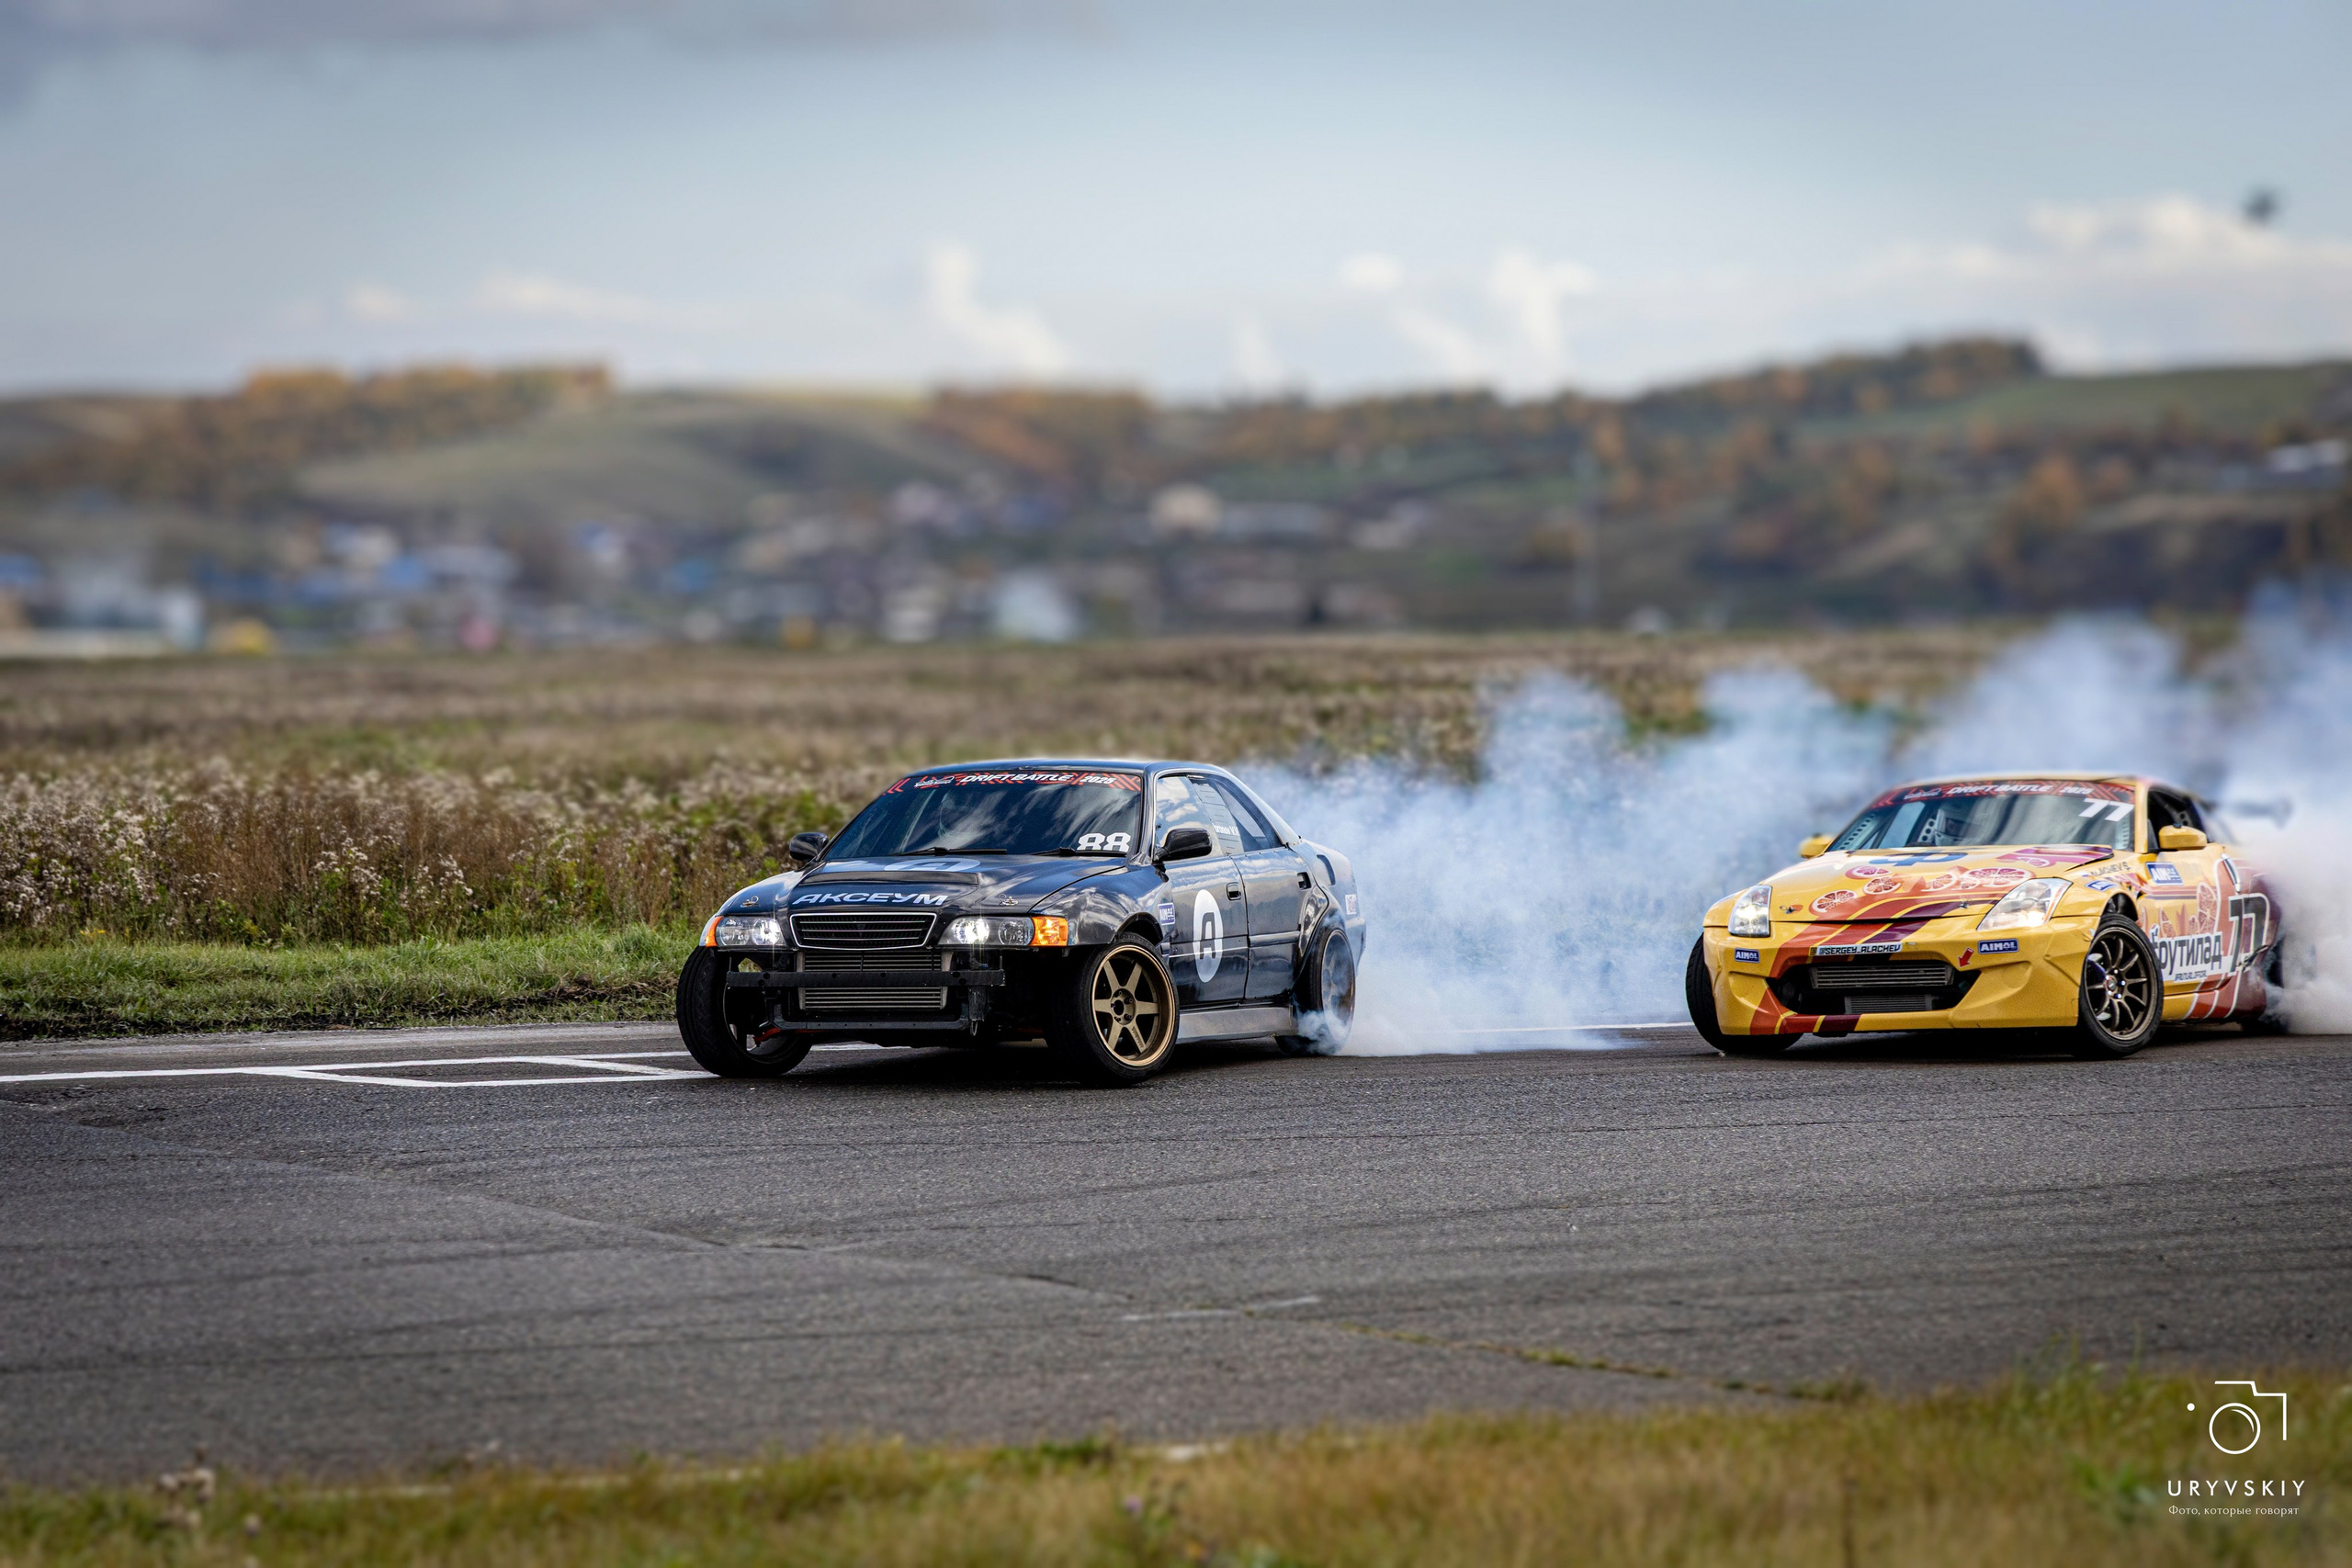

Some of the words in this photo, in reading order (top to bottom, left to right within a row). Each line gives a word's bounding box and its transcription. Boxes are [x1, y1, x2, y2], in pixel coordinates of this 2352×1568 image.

[960, 774, 1012, 783] DRIFT
[1080, 775, 1116, 784] 2025
[1947, 785, 1997, 795] DRIFT
[2078, 798, 2134, 822] 77
[1076, 832, 1131, 852] 88
[2228, 894, 2269, 976] 77
[1980, 942, 2017, 952] AIMOL
[2151, 930, 2222, 975] рутилад
